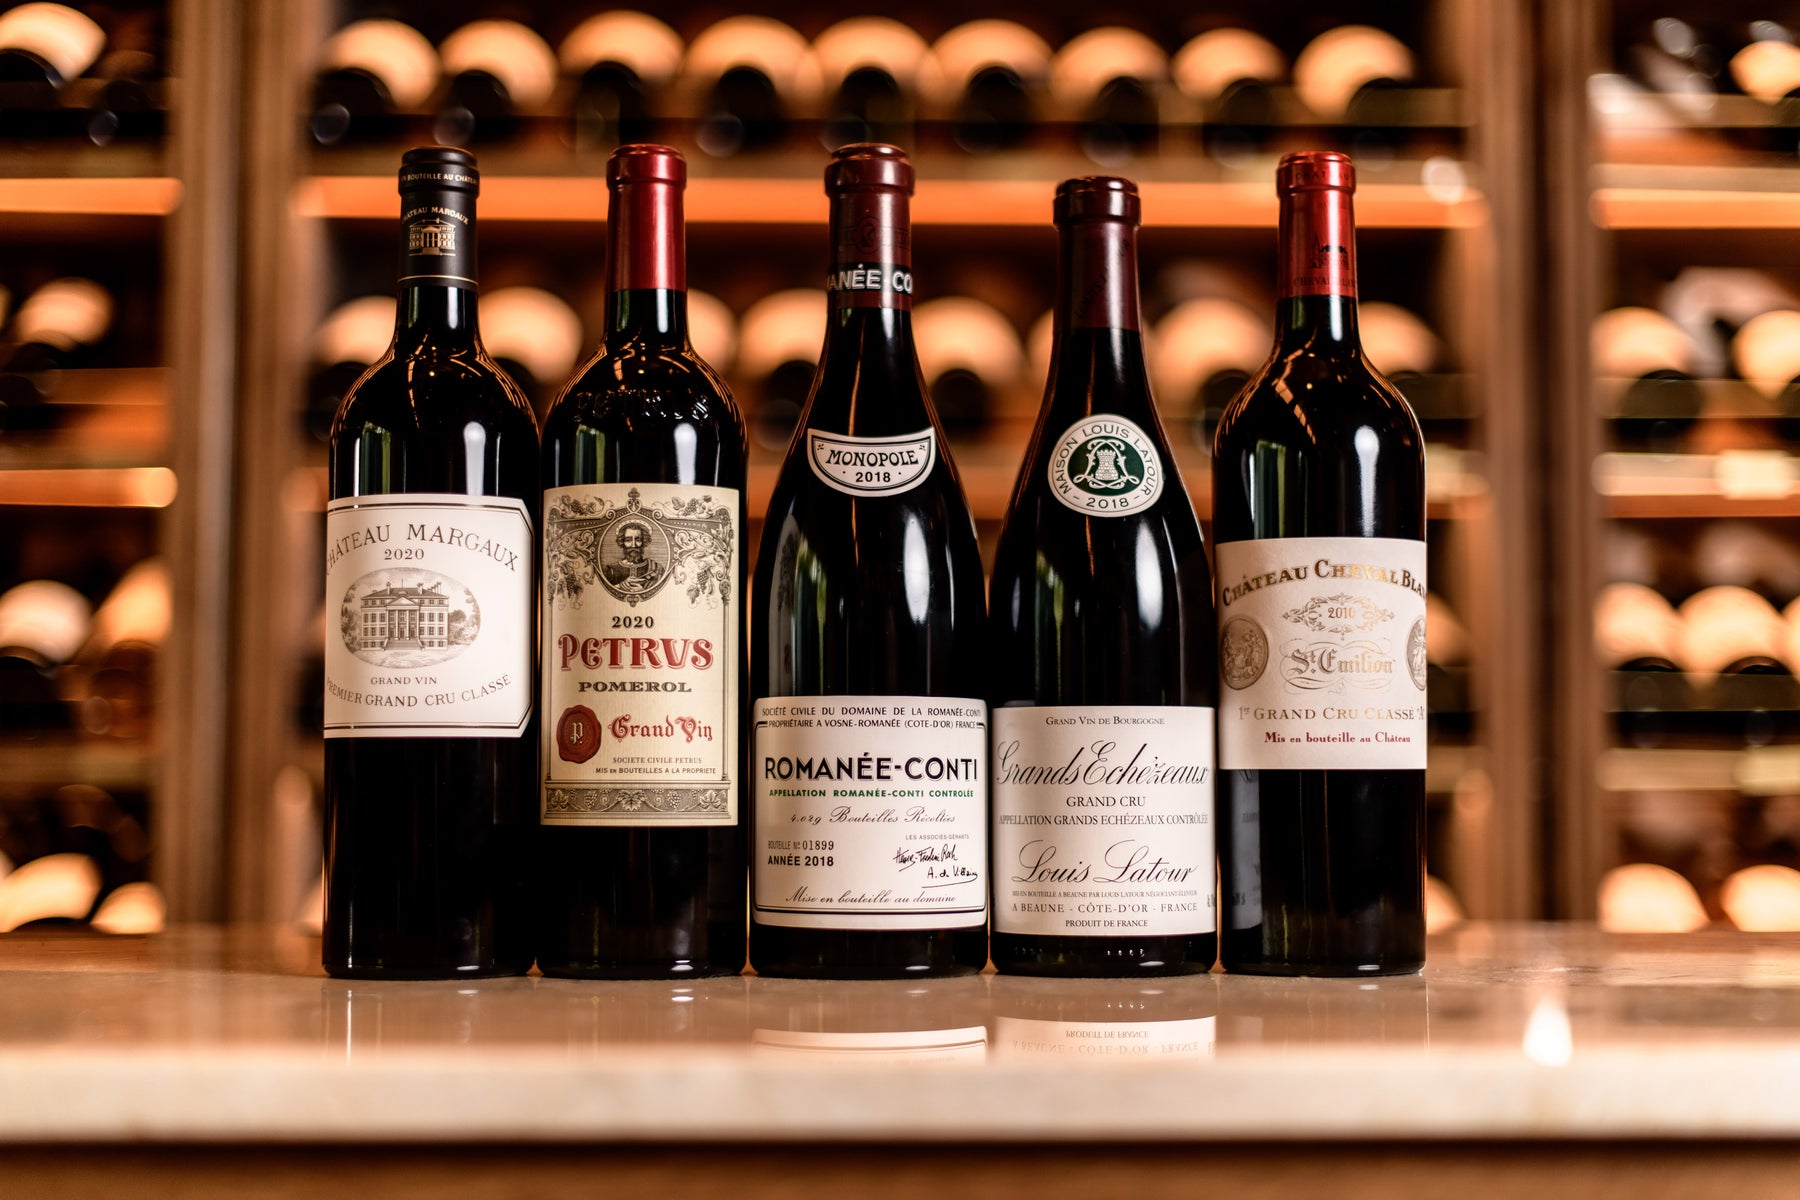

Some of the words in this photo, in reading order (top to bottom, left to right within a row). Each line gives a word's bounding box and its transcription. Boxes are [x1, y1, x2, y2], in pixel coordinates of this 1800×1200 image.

[431, 206, 469, 225] MARGAUX
[1082, 424, 1130, 439] LOUIS
[825, 450, 919, 467] MONOPOLE
[1055, 437, 1079, 495] MAISON
[1134, 438, 1156, 496] LATOUR
[855, 472, 891, 483] 2018
[1086, 497, 1130, 509] 2018
[384, 548, 425, 561] 2020
[406, 523, 519, 573] MARGAUX
[1222, 565, 1309, 607] CHÂTEAU
[1314, 559, 1399, 585] CHEVAL
[611, 615, 655, 629] 2020
[370, 676, 412, 686] GRAND
[415, 676, 438, 685] VIN
[578, 681, 692, 693] POMEROL
[365, 694, 419, 708] GRAND
[424, 692, 456, 707] CRU
[762, 706, 787, 717] SOCIÉTÉ
[790, 706, 817, 716] CIVILE
[821, 706, 836, 716] DU
[841, 706, 888, 716] DOMAINE
[893, 706, 907, 716] DE
[911, 706, 923, 717] LA
[927, 706, 982, 717] ROMANÉE-CONTI
[1253, 707, 1317, 720] GRAND
[1322, 707, 1359, 720] CRU
[607, 713, 675, 743] Grand
[674, 716, 713, 744] Vin
[768, 719, 814, 728] PROPRIÉTAIRE
[816, 719, 823, 728] A
[955, 720, 976, 729] FRANCE
[1264, 731, 1286, 743] Mis
[1306, 731, 1356, 743] bouteille
[1374, 731, 1411, 743] Château
[764, 751, 978, 781] ROMANÉE-CONTI
[996, 740, 1083, 786] Grands
[768, 789, 827, 798] APPELLATION
[833, 787, 925, 798] ROMANÉE-CONTI
[1066, 796, 1117, 807] GRAND
[1119, 796, 1146, 807] CRU
[829, 805, 900, 823] Bouteilles
[999, 814, 1052, 825] APPELLATION
[1053, 815, 1098, 826] GRANDS
[767, 840, 791, 850] BOUTEILLE
[802, 839, 835, 851] 01899
[767, 852, 801, 866] ANNÉE
[804, 855, 835, 867] 2018
[1011, 839, 1092, 884] Louis
[1093, 839, 1199, 884] Latour
[785, 886, 818, 903] Mise
[820, 895, 835, 903] en
[837, 889, 893, 903] bouteille
[912, 890, 957, 903] domaine
[1028, 890, 1057, 898] BOUTEILLE
[1012, 904, 1018, 913] A
[1021, 903, 1065, 913] BEAUNE
[1161, 902, 1198, 913] FRANCE
[1065, 919, 1102, 927] PRODUIT
[1103, 919, 1115, 927] DE
[1116, 919, 1149, 927] FRANCE
